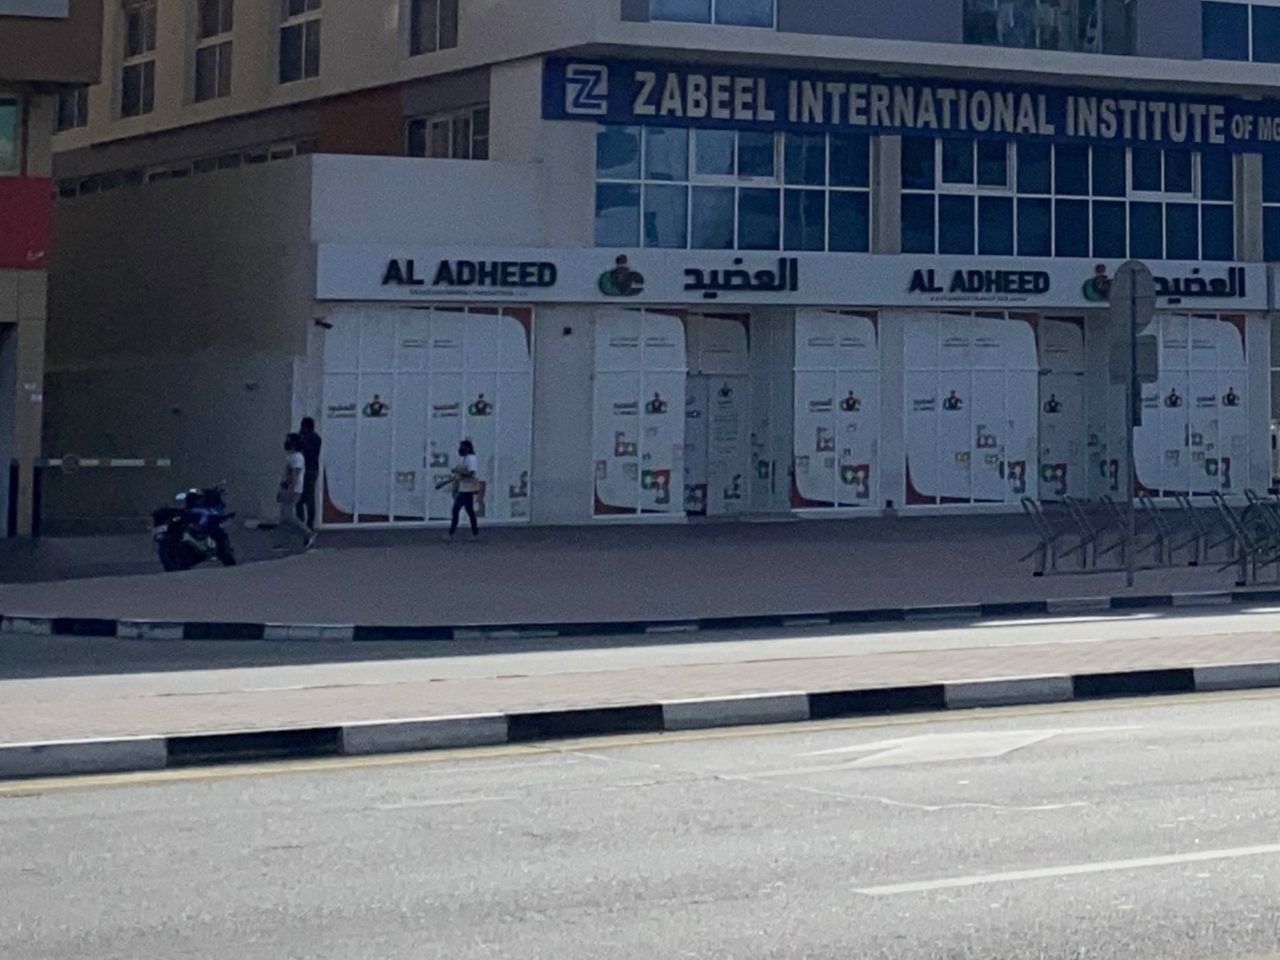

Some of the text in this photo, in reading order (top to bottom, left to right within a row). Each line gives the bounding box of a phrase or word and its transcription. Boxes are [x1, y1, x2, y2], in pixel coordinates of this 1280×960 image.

[633, 70, 776, 121] ZABEEL
[788, 80, 1055, 135] INTERNATIONAL
[1066, 95, 1226, 144] INSTITUTE
[1231, 114, 1253, 139] OF
[381, 259, 557, 288] AL ADHEED
[684, 257, 798, 298] العضيد
[909, 269, 1050, 295] AL ADHEED
[1153, 266, 1246, 305] العضيد
